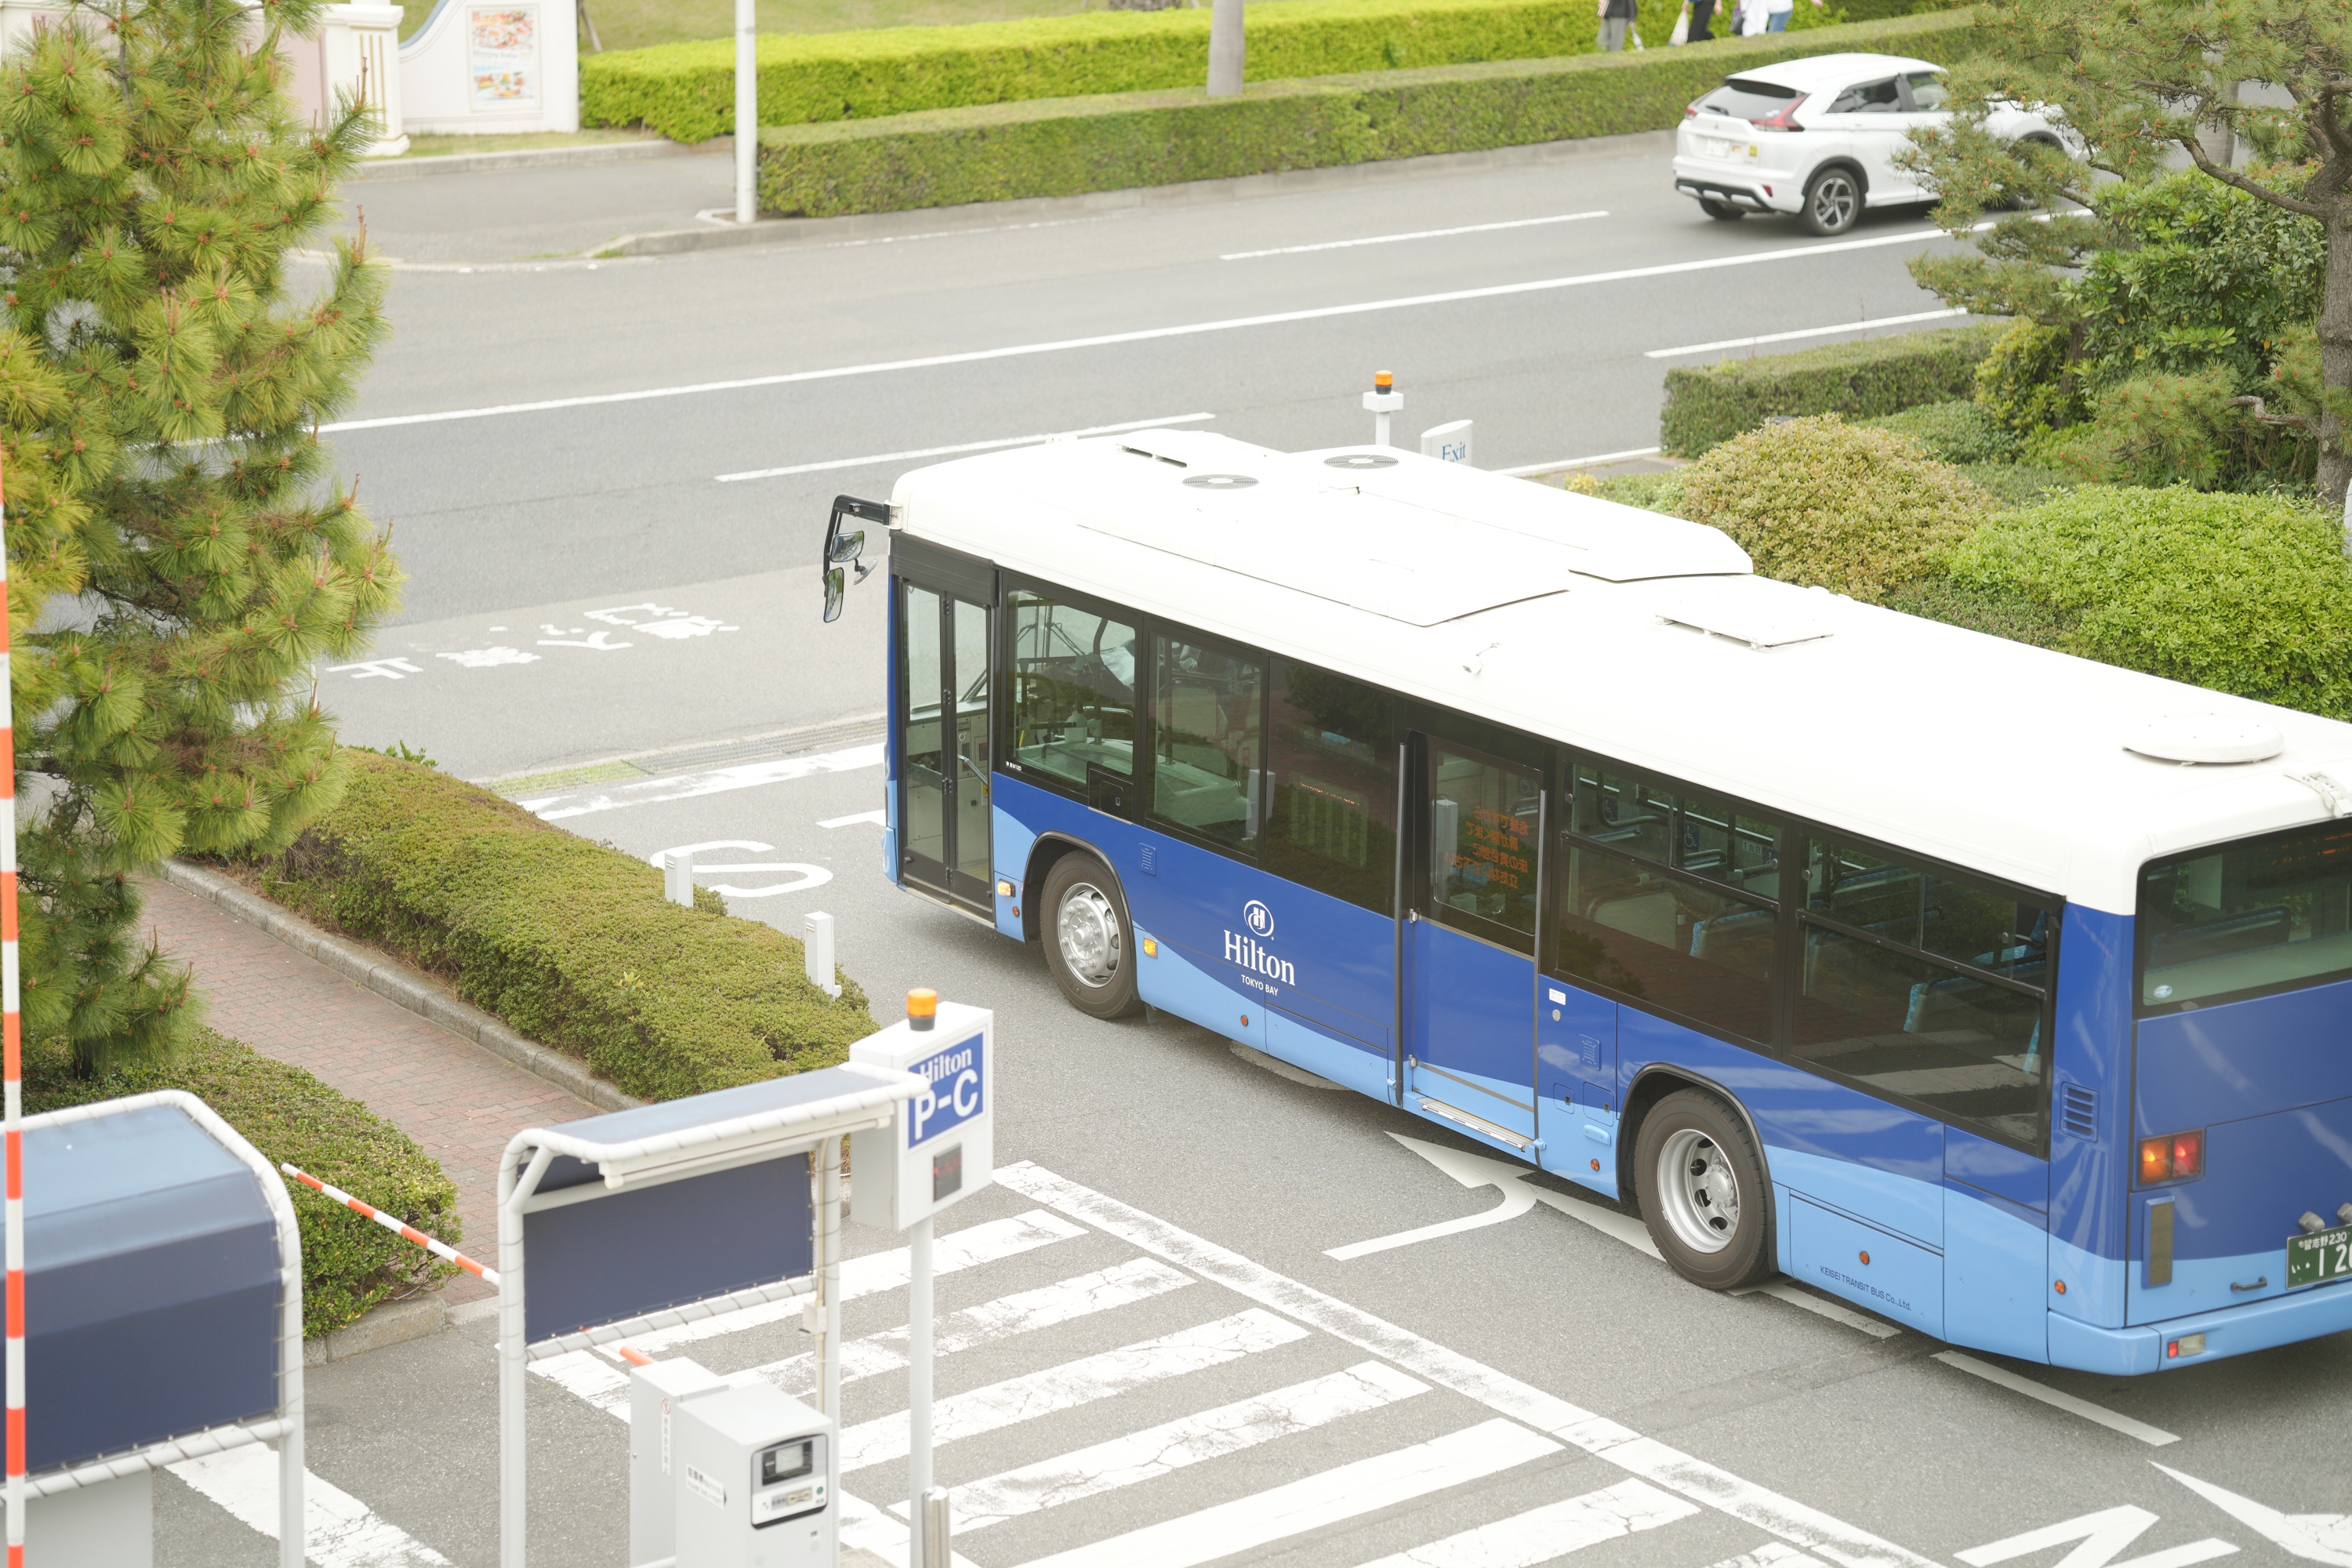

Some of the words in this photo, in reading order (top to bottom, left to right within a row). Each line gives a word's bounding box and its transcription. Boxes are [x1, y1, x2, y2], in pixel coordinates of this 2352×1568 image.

[1442, 441, 1466, 462] Exit
[1744, 841, 1761, 854] 1台目
[1224, 929, 1295, 986] Hilton
[1241, 974, 1264, 990] TOKYO
[1265, 983, 1279, 996] BAY
[920, 1047, 973, 1083] Hilton
[914, 1068, 978, 1141] P-C
[1820, 1265, 1841, 1281] KEISEI
[1842, 1274, 1870, 1293] TRANSIT
[1871, 1287, 1885, 1300] BUS
